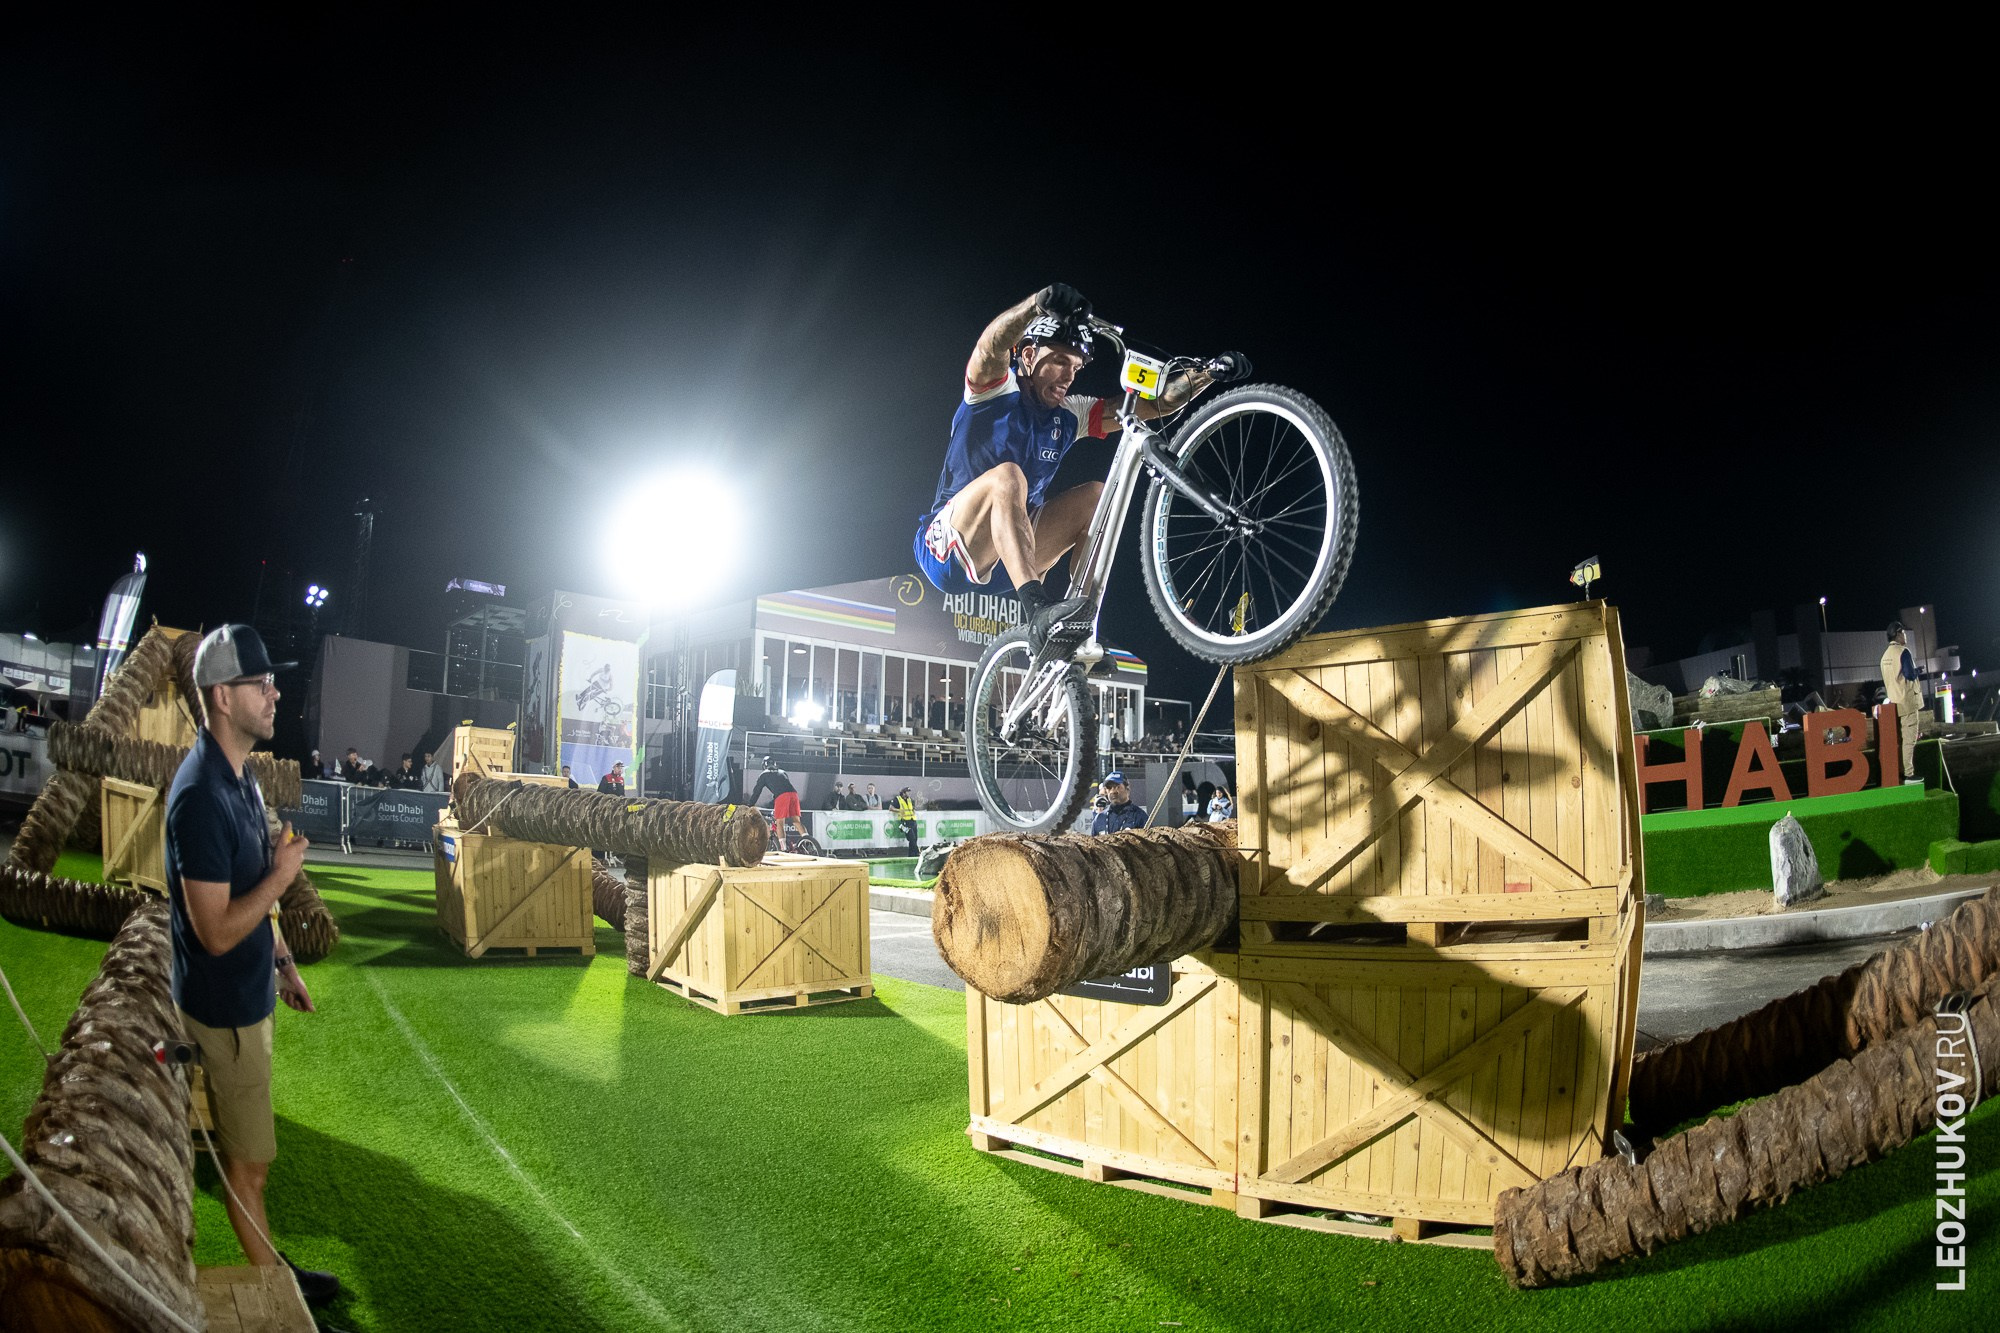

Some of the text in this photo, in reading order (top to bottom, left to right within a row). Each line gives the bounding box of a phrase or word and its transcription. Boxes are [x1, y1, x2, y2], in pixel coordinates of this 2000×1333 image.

[1136, 368, 1148, 383] 5
[942, 592, 1021, 626] ABU DHABI
[953, 613, 968, 630] UCI
[969, 616, 998, 635] URBAN
[957, 628, 983, 645] WORLD
[708, 720, 721, 728] UCI
[1634, 703, 1900, 815] HABI
[302, 794, 328, 807] Dhabi
[304, 805, 328, 816] Council
[378, 802, 424, 815] Abu Dhabi
[378, 812, 424, 824] Sports Council
